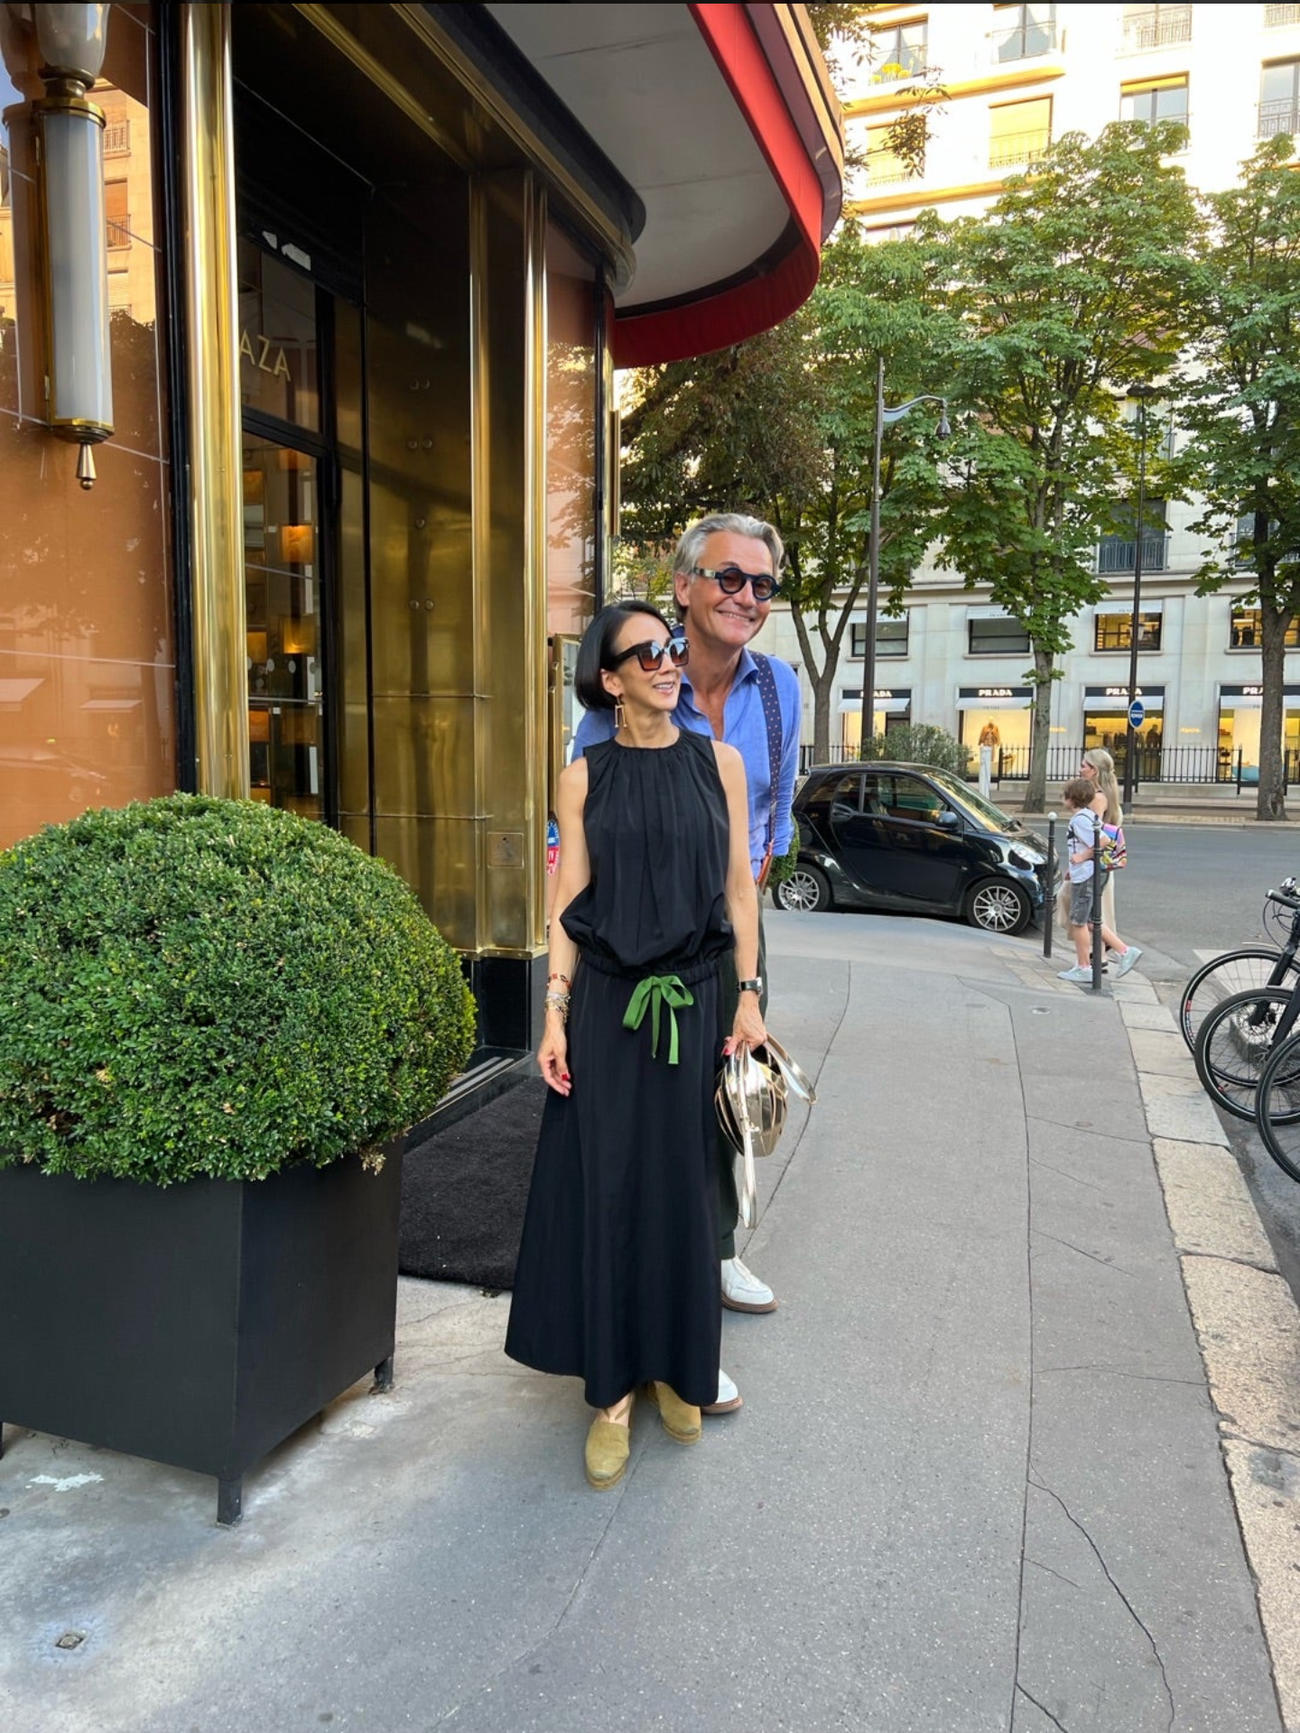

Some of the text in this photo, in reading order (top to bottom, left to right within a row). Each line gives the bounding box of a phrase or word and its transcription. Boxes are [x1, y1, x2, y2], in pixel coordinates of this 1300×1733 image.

[860, 690, 892, 698] ADA
[978, 688, 1013, 697] PRADA
[1105, 687, 1143, 696] PRAA
